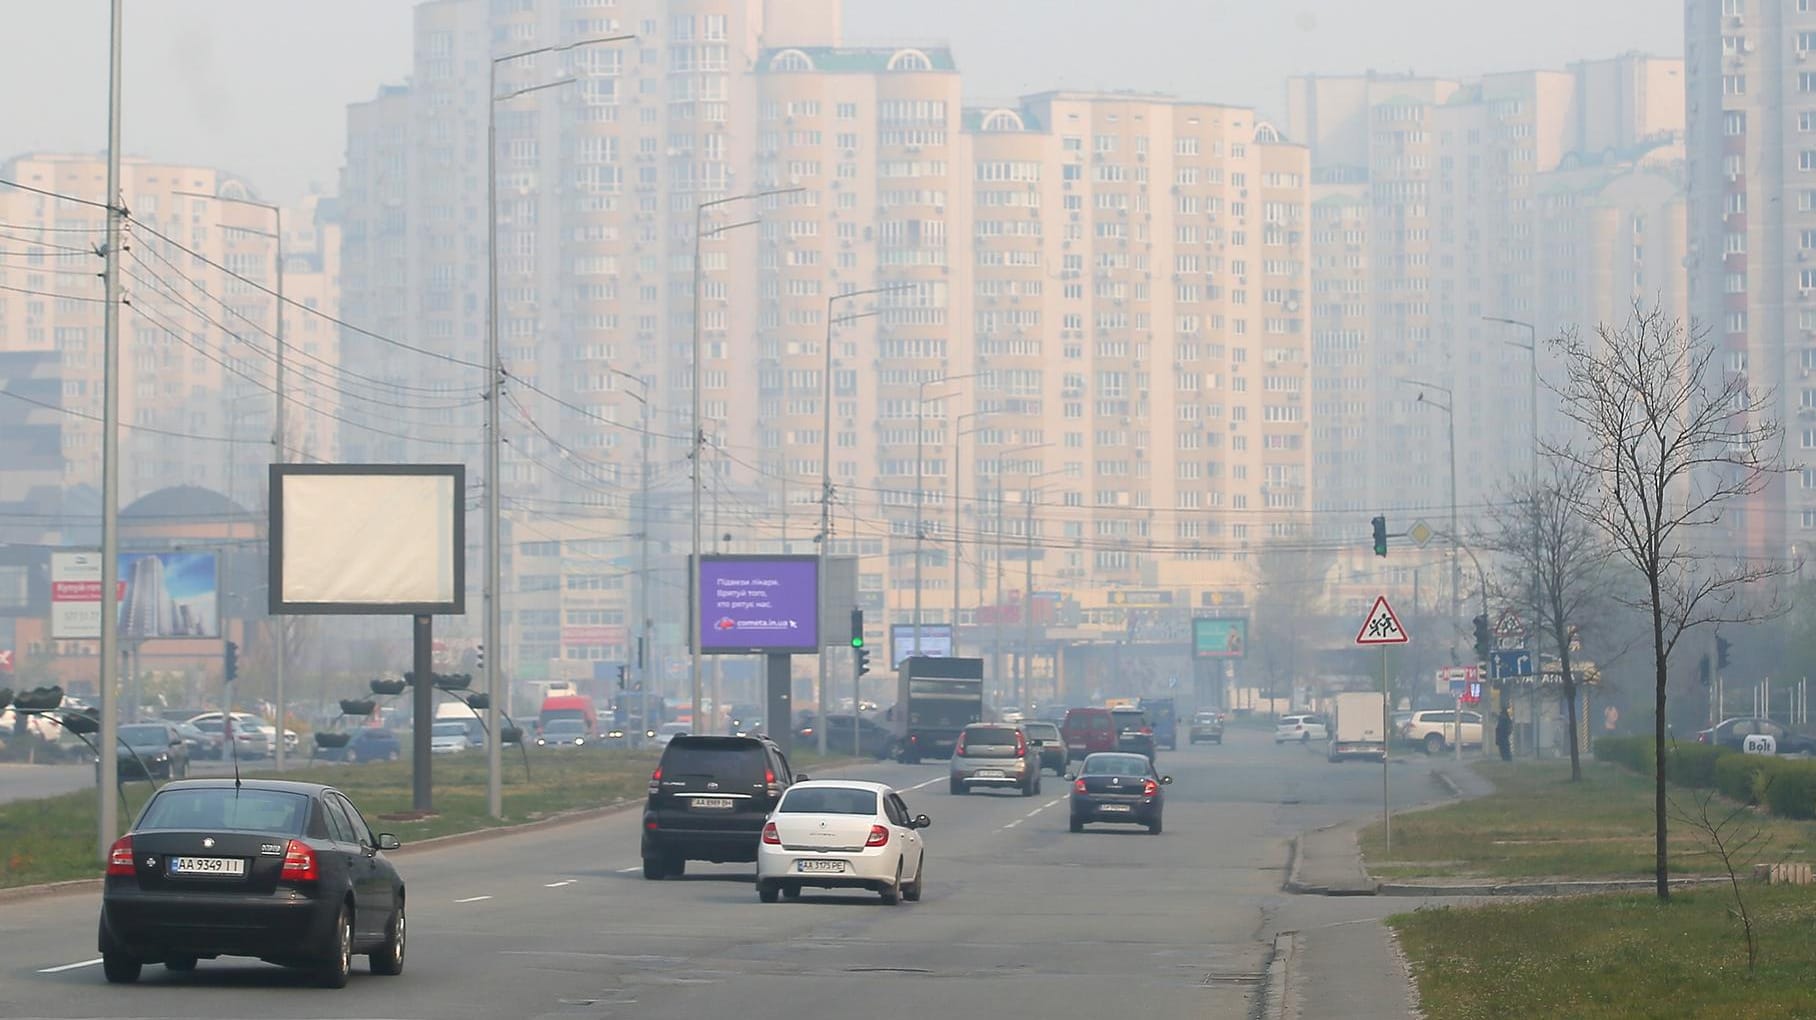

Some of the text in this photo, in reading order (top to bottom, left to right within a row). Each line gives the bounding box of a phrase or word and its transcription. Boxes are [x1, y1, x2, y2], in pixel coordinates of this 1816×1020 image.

[736, 619, 789, 628] cometa.in.ua
[1749, 738, 1771, 752] Bolt
[178, 858, 195, 870] AA
[196, 858, 223, 871] 9349
